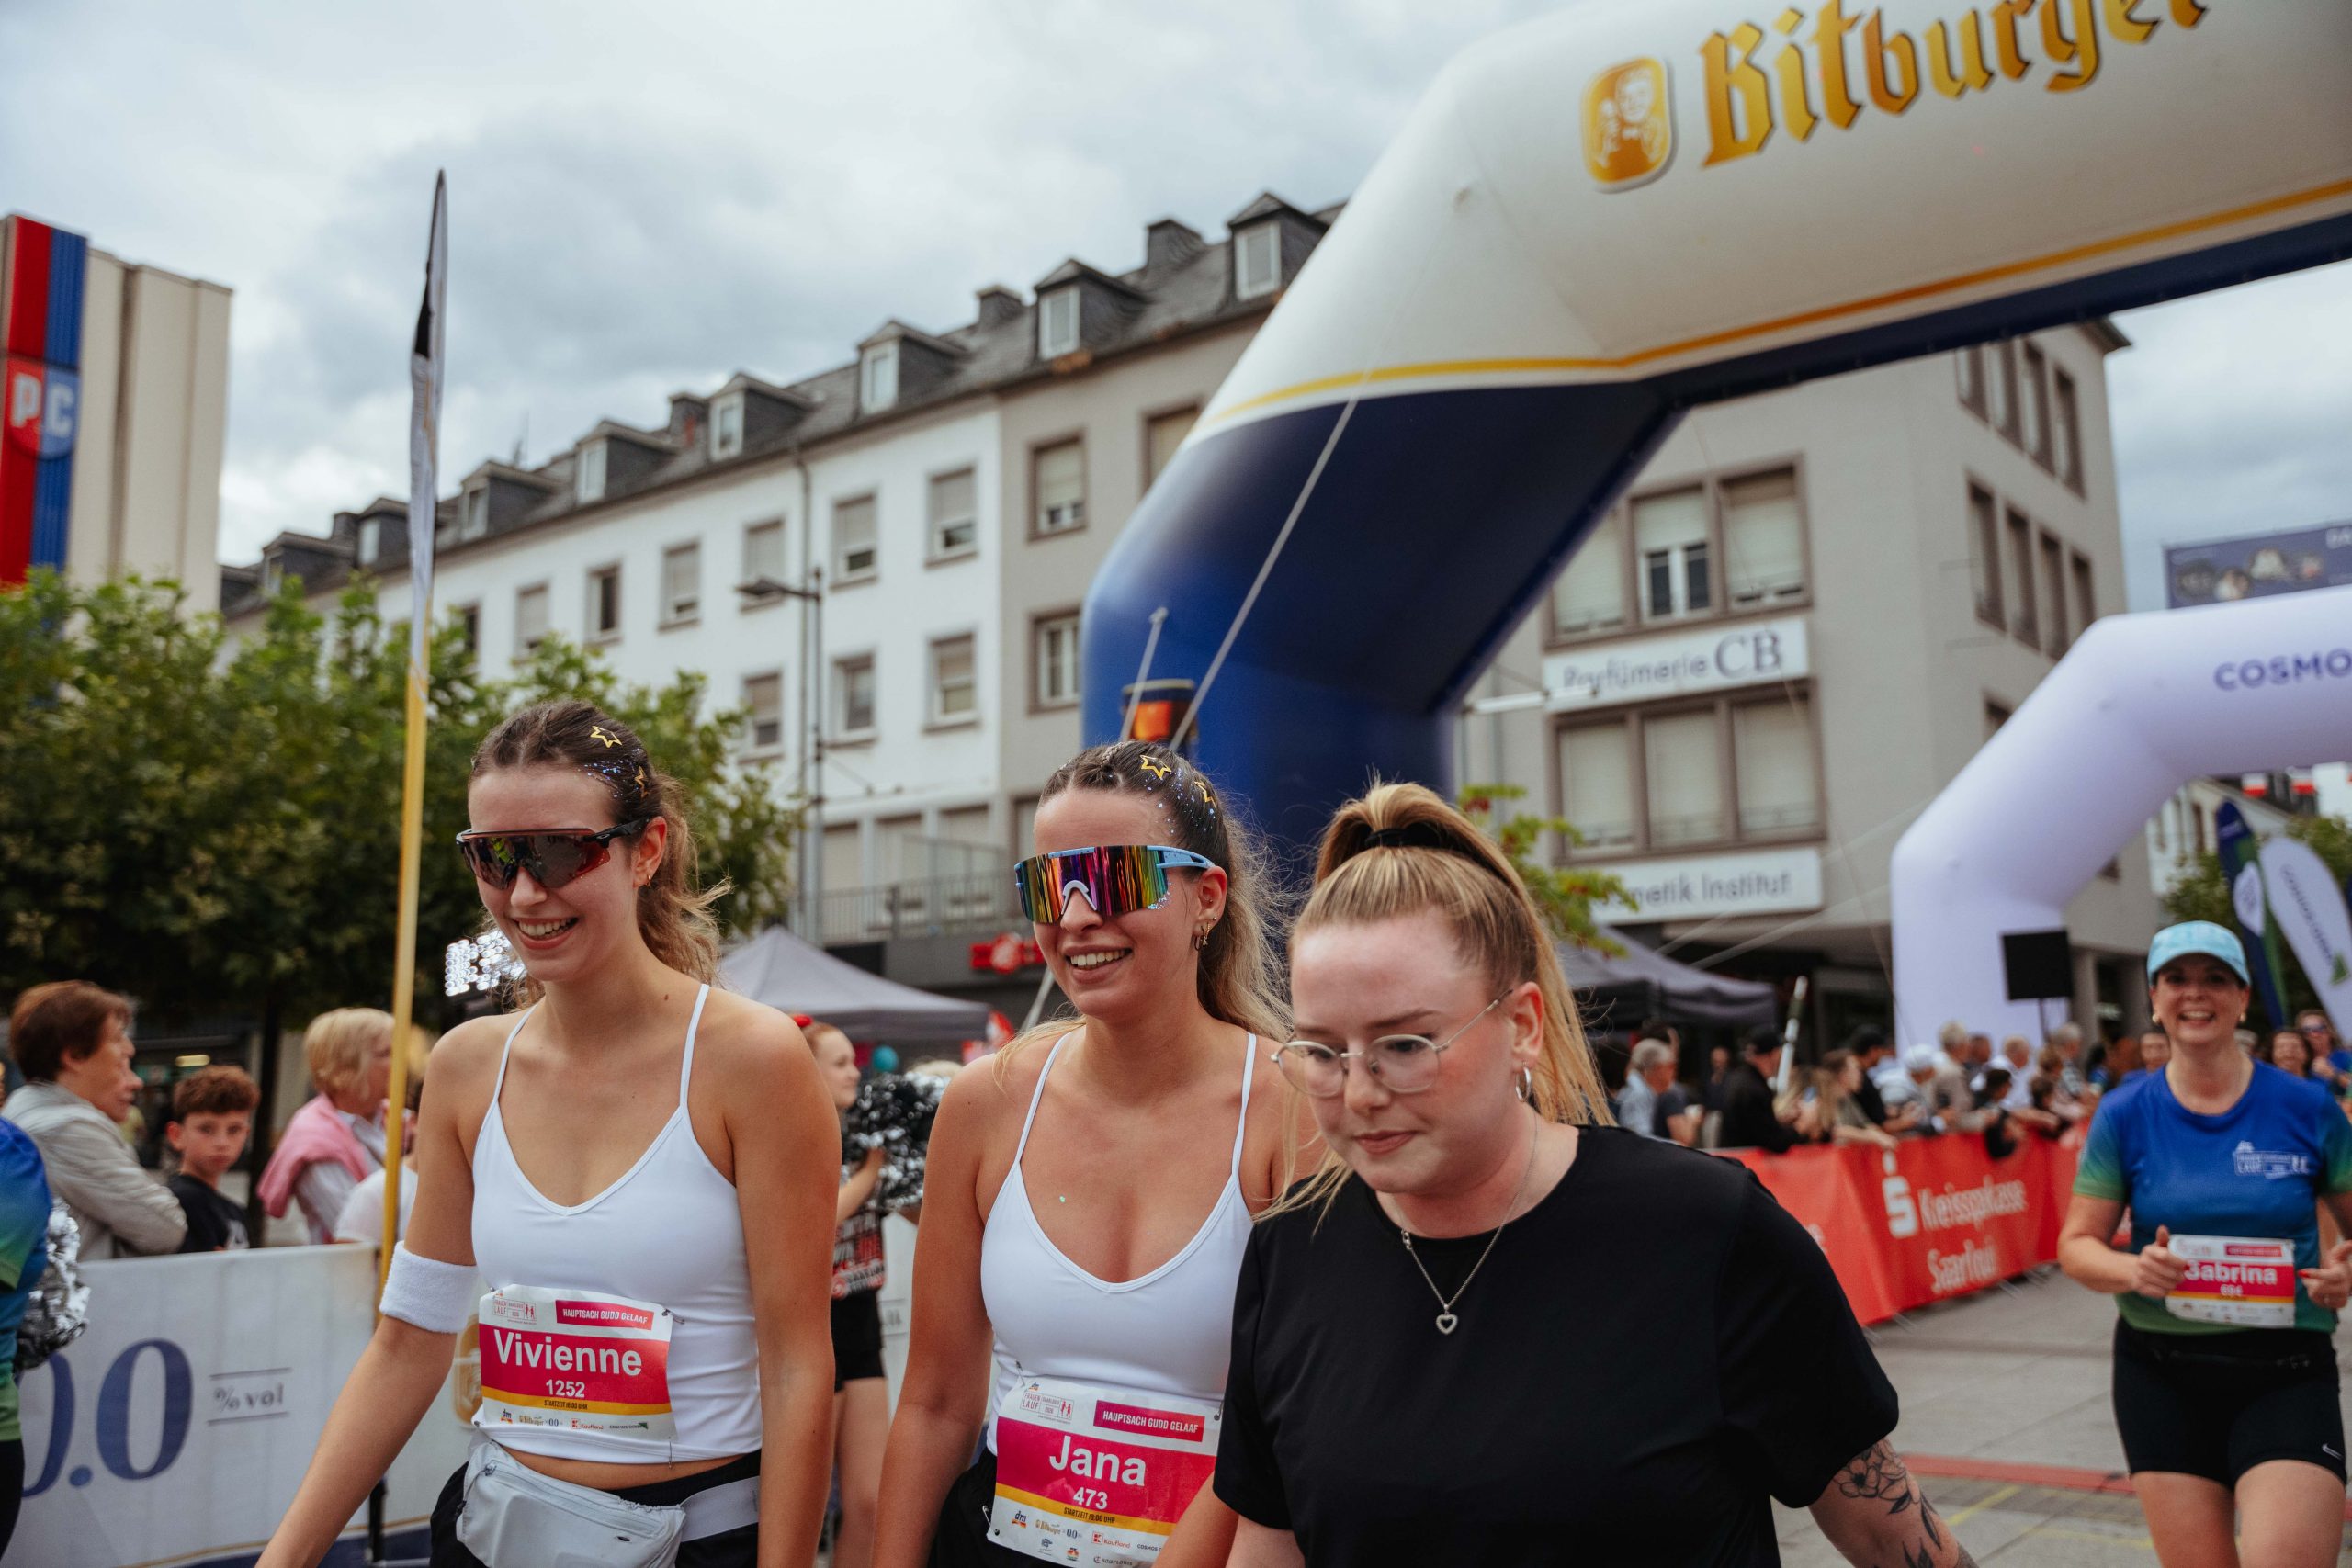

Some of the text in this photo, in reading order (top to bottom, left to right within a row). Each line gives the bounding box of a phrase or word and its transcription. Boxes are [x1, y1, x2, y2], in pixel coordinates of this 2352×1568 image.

[1714, 627, 1783, 680] CB
[1702, 870, 1791, 901] Institut
[563, 1308, 648, 1324] HAUPTSACH GUDD GELAAF
[493, 1329, 642, 1376] Vivienne
[244, 1382, 284, 1409] vol
[546, 1379, 585, 1398] 1252
[1103, 1410, 1198, 1434] HAUPTSACH GUDD GELAAF
[1049, 1435, 1148, 1487] Jana
[1073, 1487, 1108, 1510] 473
[1014, 1510, 1027, 1523] dm
[1064, 1507, 1115, 1524] STARTZEIT 18:00 UHR
[1104, 1539, 1131, 1549] Kaufland
